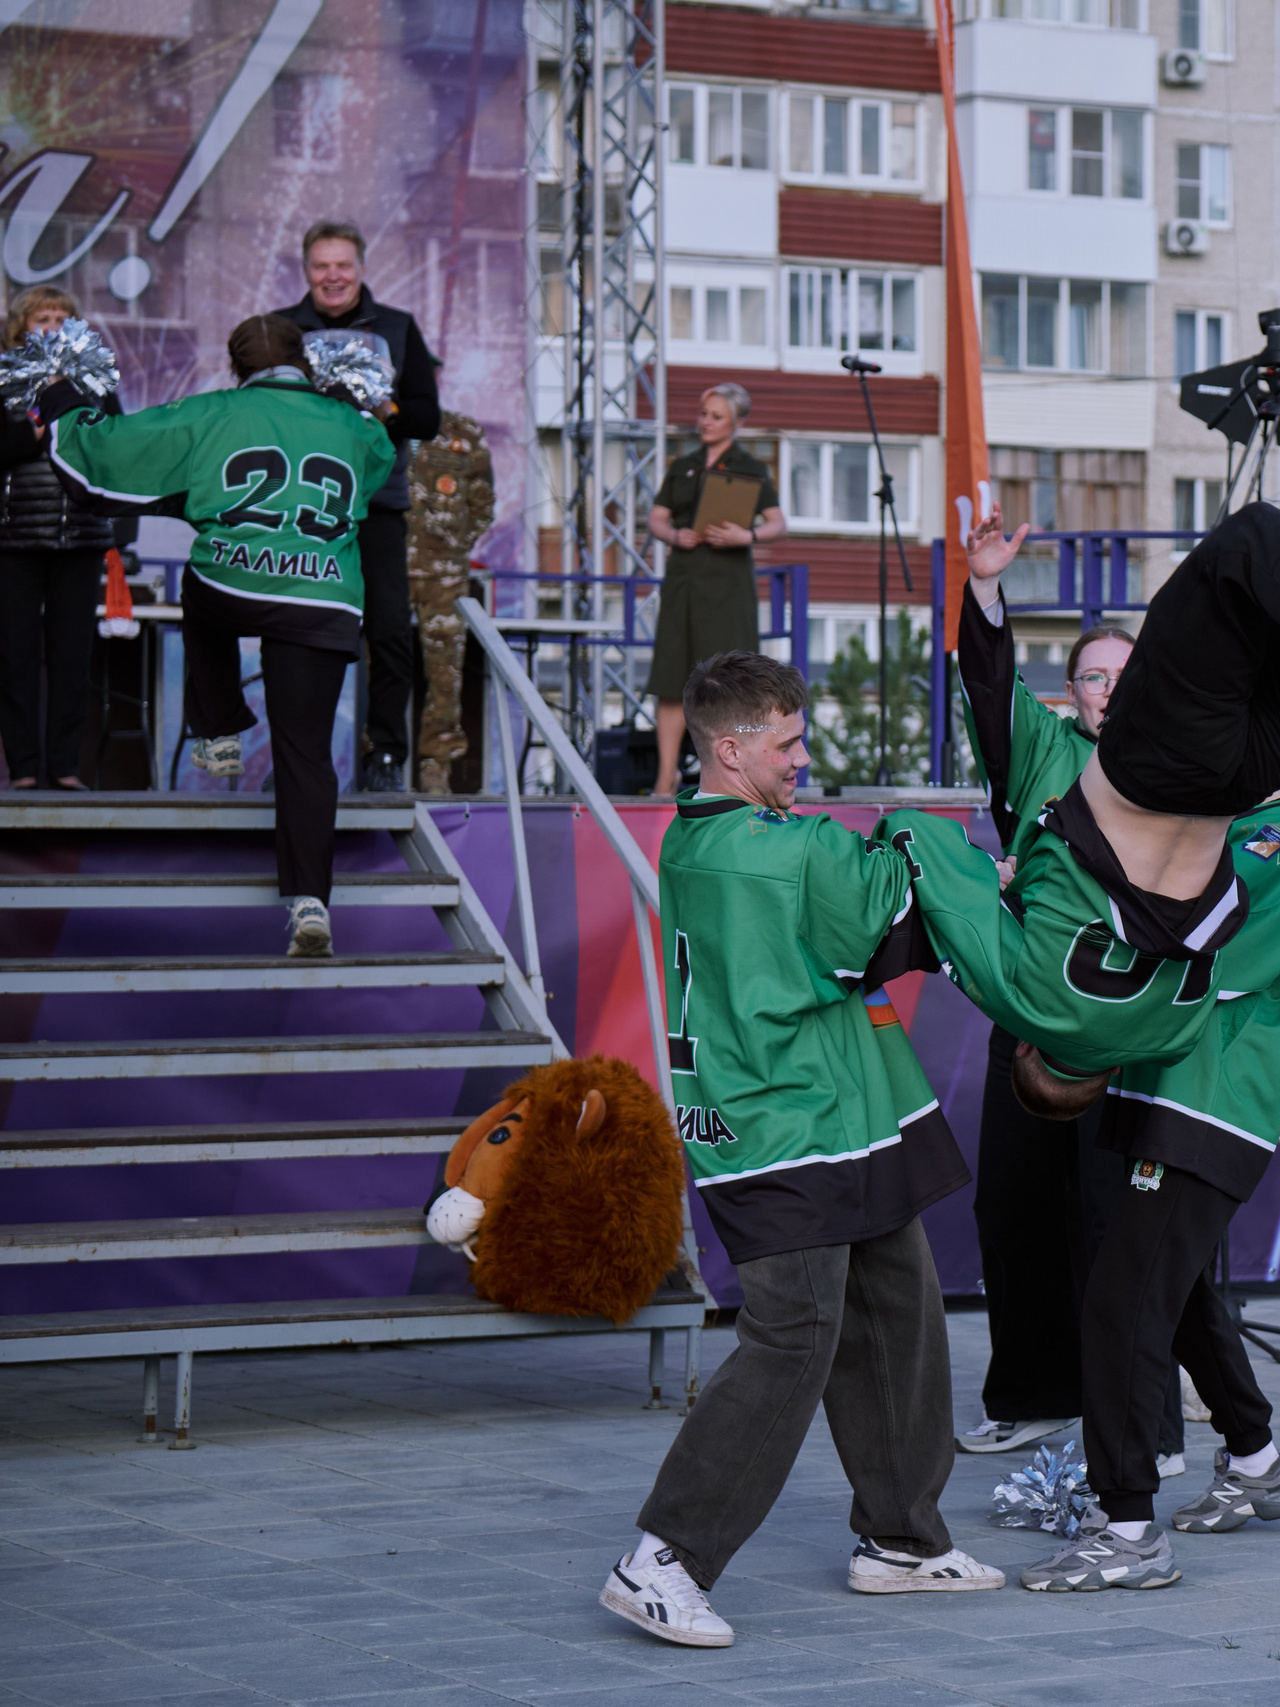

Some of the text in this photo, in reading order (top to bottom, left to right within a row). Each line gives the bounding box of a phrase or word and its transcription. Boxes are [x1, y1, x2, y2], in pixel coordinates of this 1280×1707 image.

[216, 445, 357, 544] 23
[209, 537, 343, 583] ТАЛИЦА
[676, 1105, 739, 1147] ИЦА
